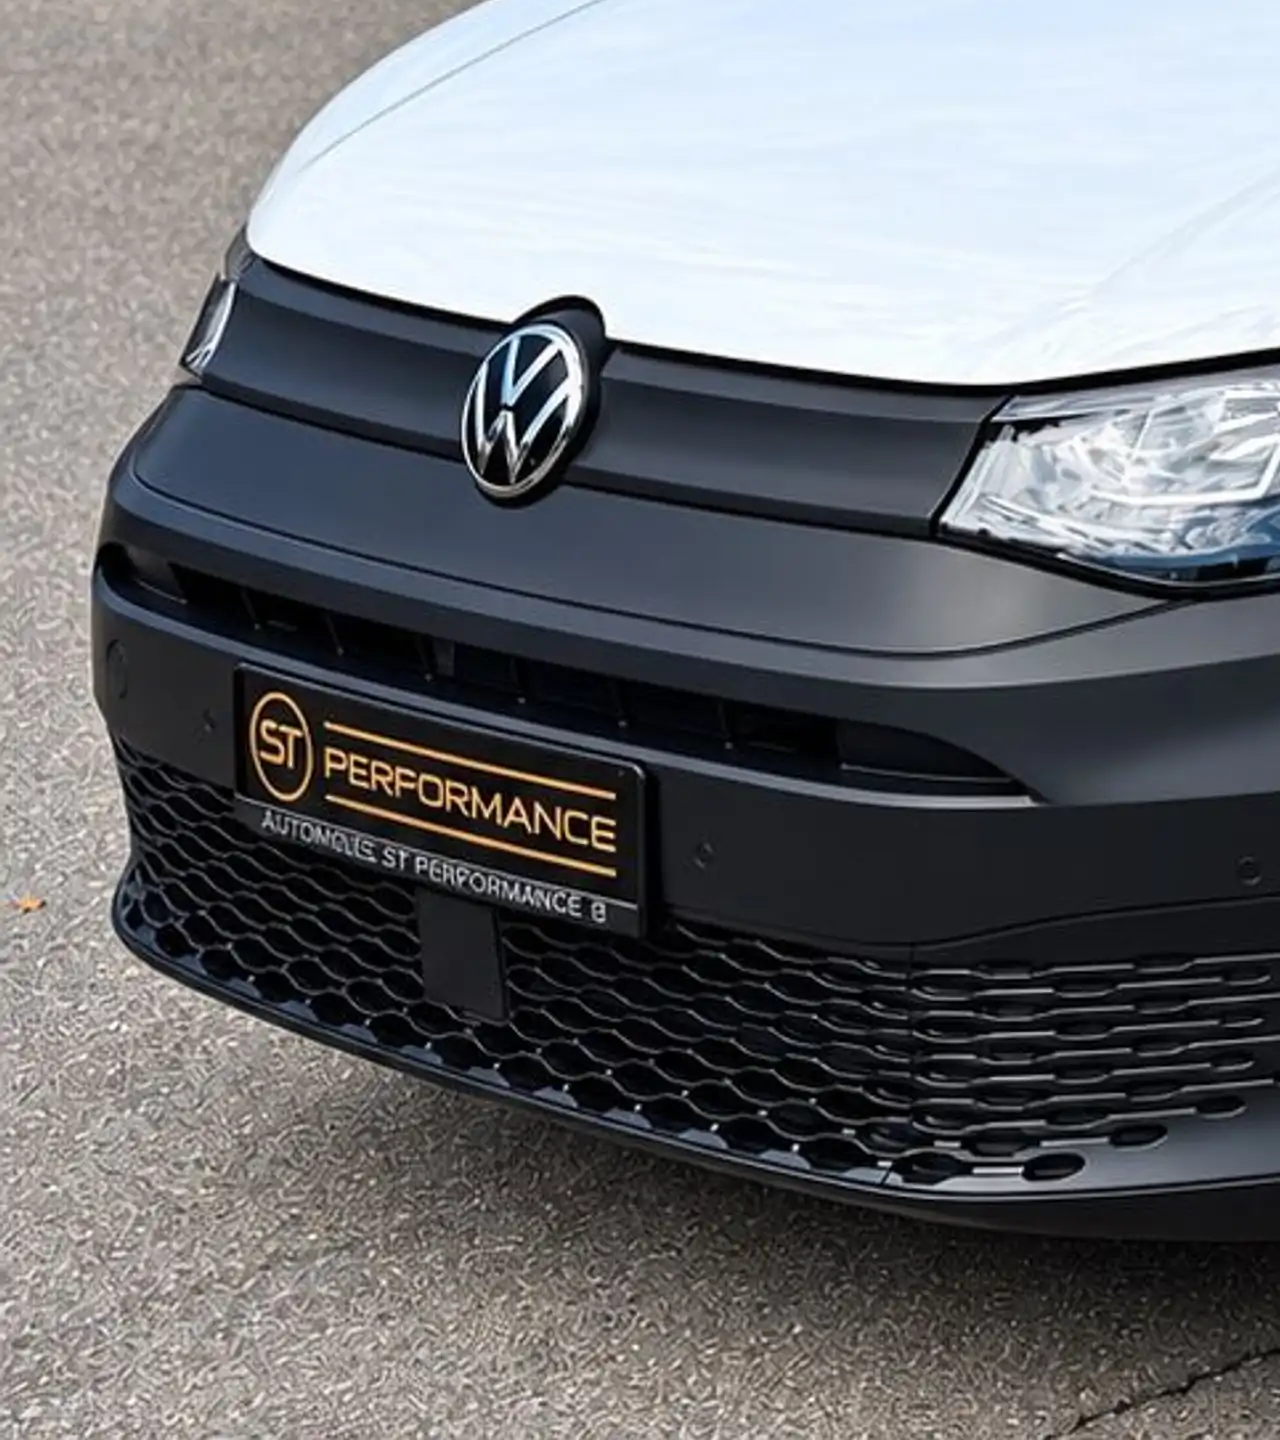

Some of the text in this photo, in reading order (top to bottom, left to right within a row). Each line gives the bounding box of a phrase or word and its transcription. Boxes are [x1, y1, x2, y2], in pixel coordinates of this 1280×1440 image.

[259, 718, 617, 853] ST PERFORMANCE
[381, 845, 410, 872] ST
[414, 856, 583, 918] PERFORMANCE
